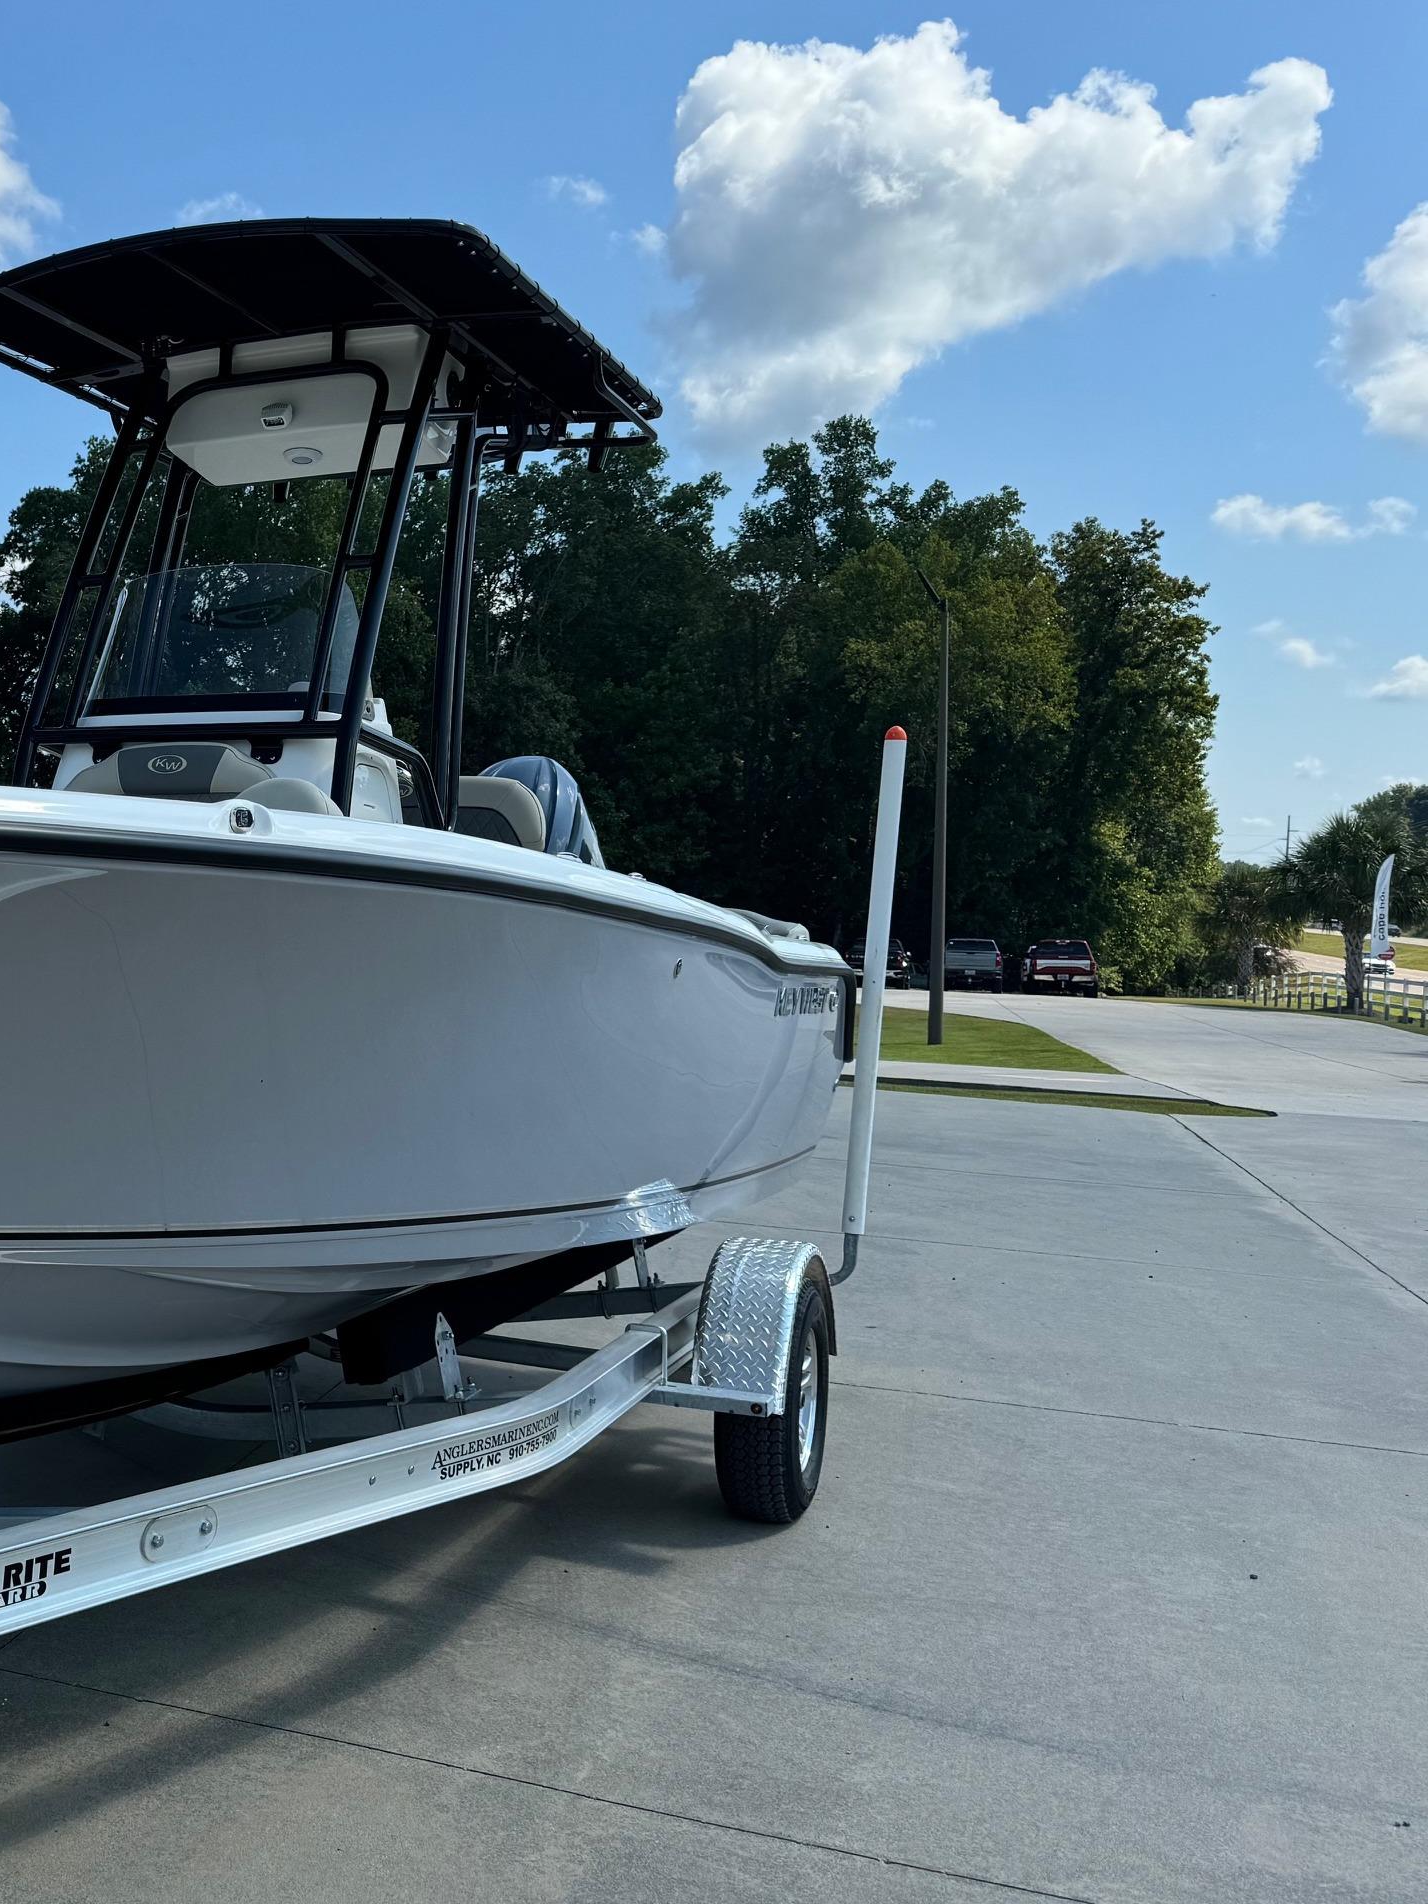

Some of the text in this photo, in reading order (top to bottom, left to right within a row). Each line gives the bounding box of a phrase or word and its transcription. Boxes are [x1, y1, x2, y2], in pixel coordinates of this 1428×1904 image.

[155, 758, 181, 770] KW
[431, 1411, 559, 1470] ANGLERSMARINENC.COM
[440, 1429, 557, 1480] SUPPLY, NC 910-755-7900
[3, 1548, 72, 1590] RITE
